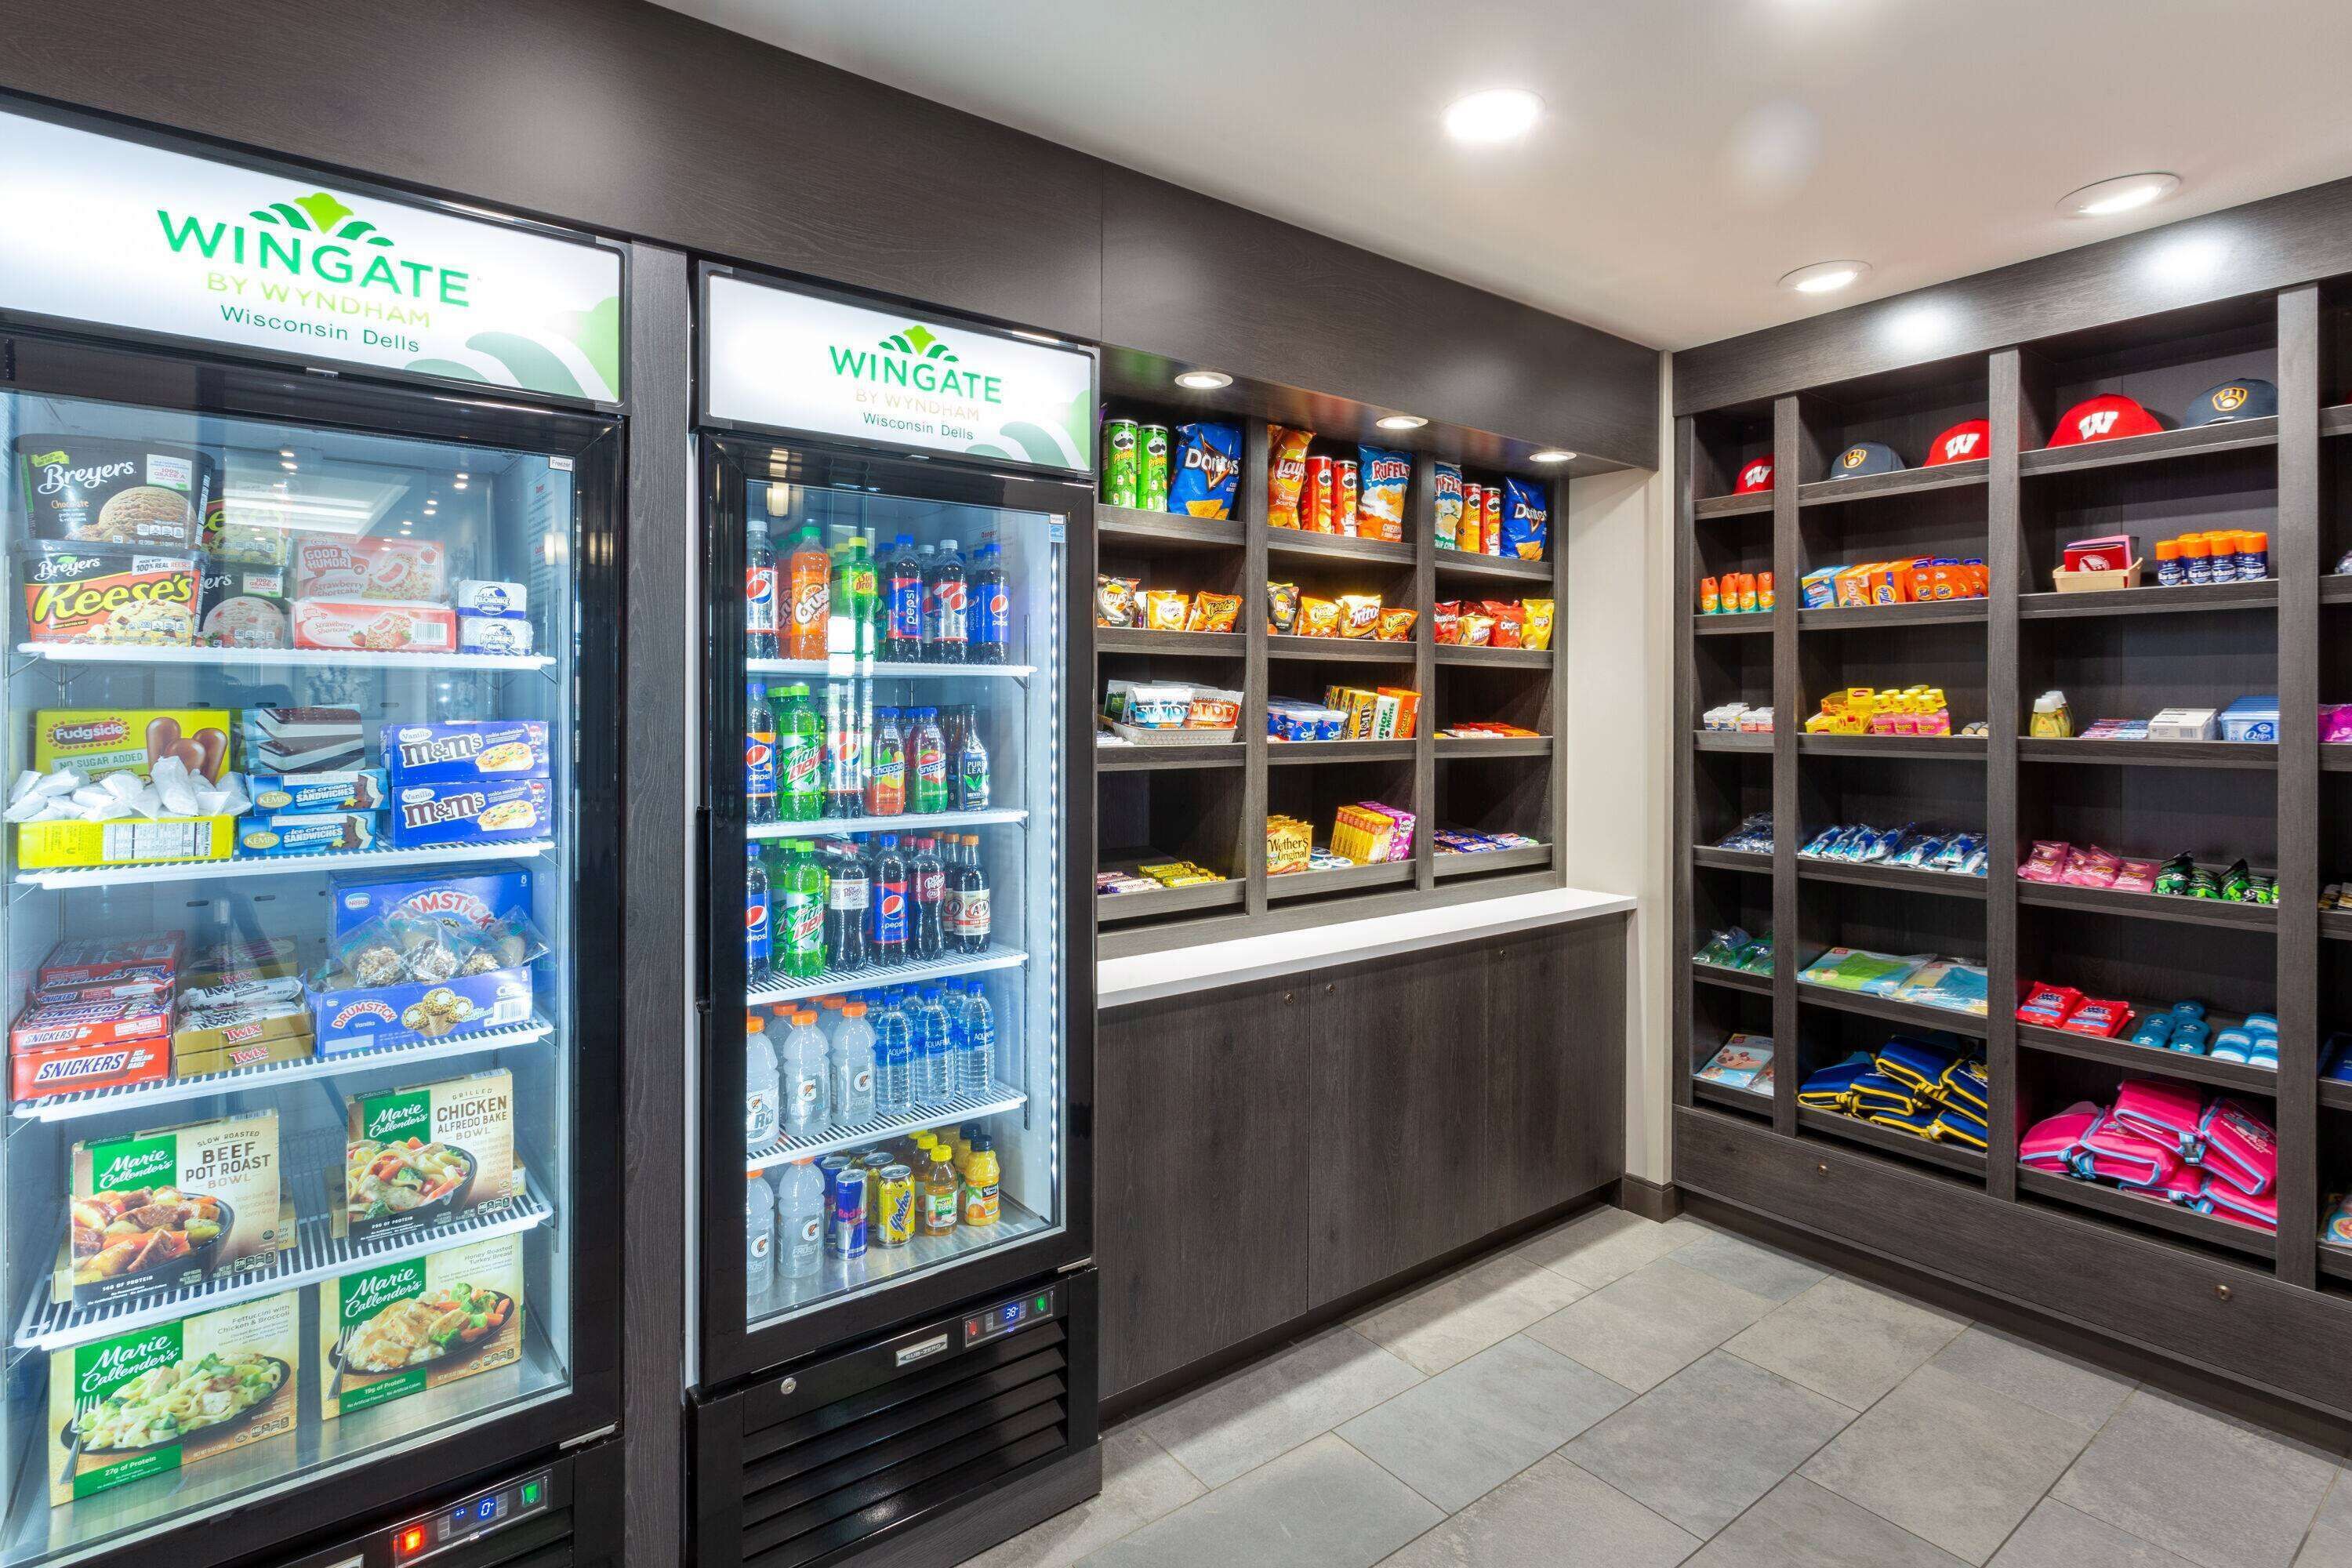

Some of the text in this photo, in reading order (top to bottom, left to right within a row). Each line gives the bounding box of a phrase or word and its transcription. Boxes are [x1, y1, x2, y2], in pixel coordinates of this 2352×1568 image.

[157, 209, 470, 307] WINGATE
[207, 272, 430, 328] BY WYNDHAM
[220, 305, 420, 353] Wisconsin Dells
[829, 346, 1002, 404] WINGATE
[855, 388, 979, 421] BY WYNDHAM
[863, 412, 974, 440] Wisconsin Dells
[2078, 412, 2118, 440] W
[1944, 433, 1980, 459] W
[1185, 448, 1239, 475] Doritos
[1373, 461, 1410, 481] RUFFLE
[38, 461, 136, 495] Breyers
[1745, 466, 1772, 488] W
[305, 550, 339, 560] GOOD
[307, 558, 348, 569] HUMOR
[34, 557, 100, 580] Breyers
[136, 564, 154, 572] 100%
[34, 574, 193, 623] Reese's
[474, 593, 510, 607] KLONDIKE
[907, 589, 916, 625] pepsi
[56, 724, 124, 740] Fudgsicle
[401, 731, 429, 739] Vanilla
[77, 757, 109, 768] SUGAR
[113, 753, 143, 763] ADDED
[319, 783, 348, 792] cream
[749, 772, 771, 782] pepsi
[296, 787, 354, 802] SANDWICHES
[405, 791, 433, 800] Vanilla
[246, 837, 278, 845] KEMPS
[284, 829, 343, 844] SANDWICHES
[1278, 849, 1307, 862] Original
[521, 875, 527, 884] 8
[521, 971, 527, 980] 8
[25, 1030, 72, 1043] SNICKERS
[39, 1054, 125, 1080] SNICKERS
[452, 1088, 492, 1100] GRILLED
[369, 1103, 424, 1127] Marie
[437, 1096, 506, 1122] CHICKEN
[369, 1113, 427, 1138] Callender's
[437, 1111, 506, 1134] ALFREDO BAKE
[197, 1131, 260, 1147] SLOW ROASTED
[456, 1127, 491, 1140] BOWL
[100, 1149, 167, 1177] Marie
[202, 1142, 256, 1163] BEEF
[100, 1160, 173, 1189] Callender's
[186, 1154, 271, 1182] POT ROAST
[208, 1175, 252, 1189] BOWL
[838, 1208, 855, 1218] Red
[487, 1245, 513, 1254] Roasted
[345, 1269, 416, 1304] Marie
[345, 1280, 423, 1318] Callender's
[218, 1322, 249, 1334] Chicken
[258, 1312, 289, 1323] Broccoli
[232, 1310, 270, 1323] Fettuccini
[82, 1336, 172, 1377] Marie
[82, 1347, 179, 1392] Callender's
[384, 1377, 406, 1388] Protein
[130, 1456, 157, 1468] Protein
